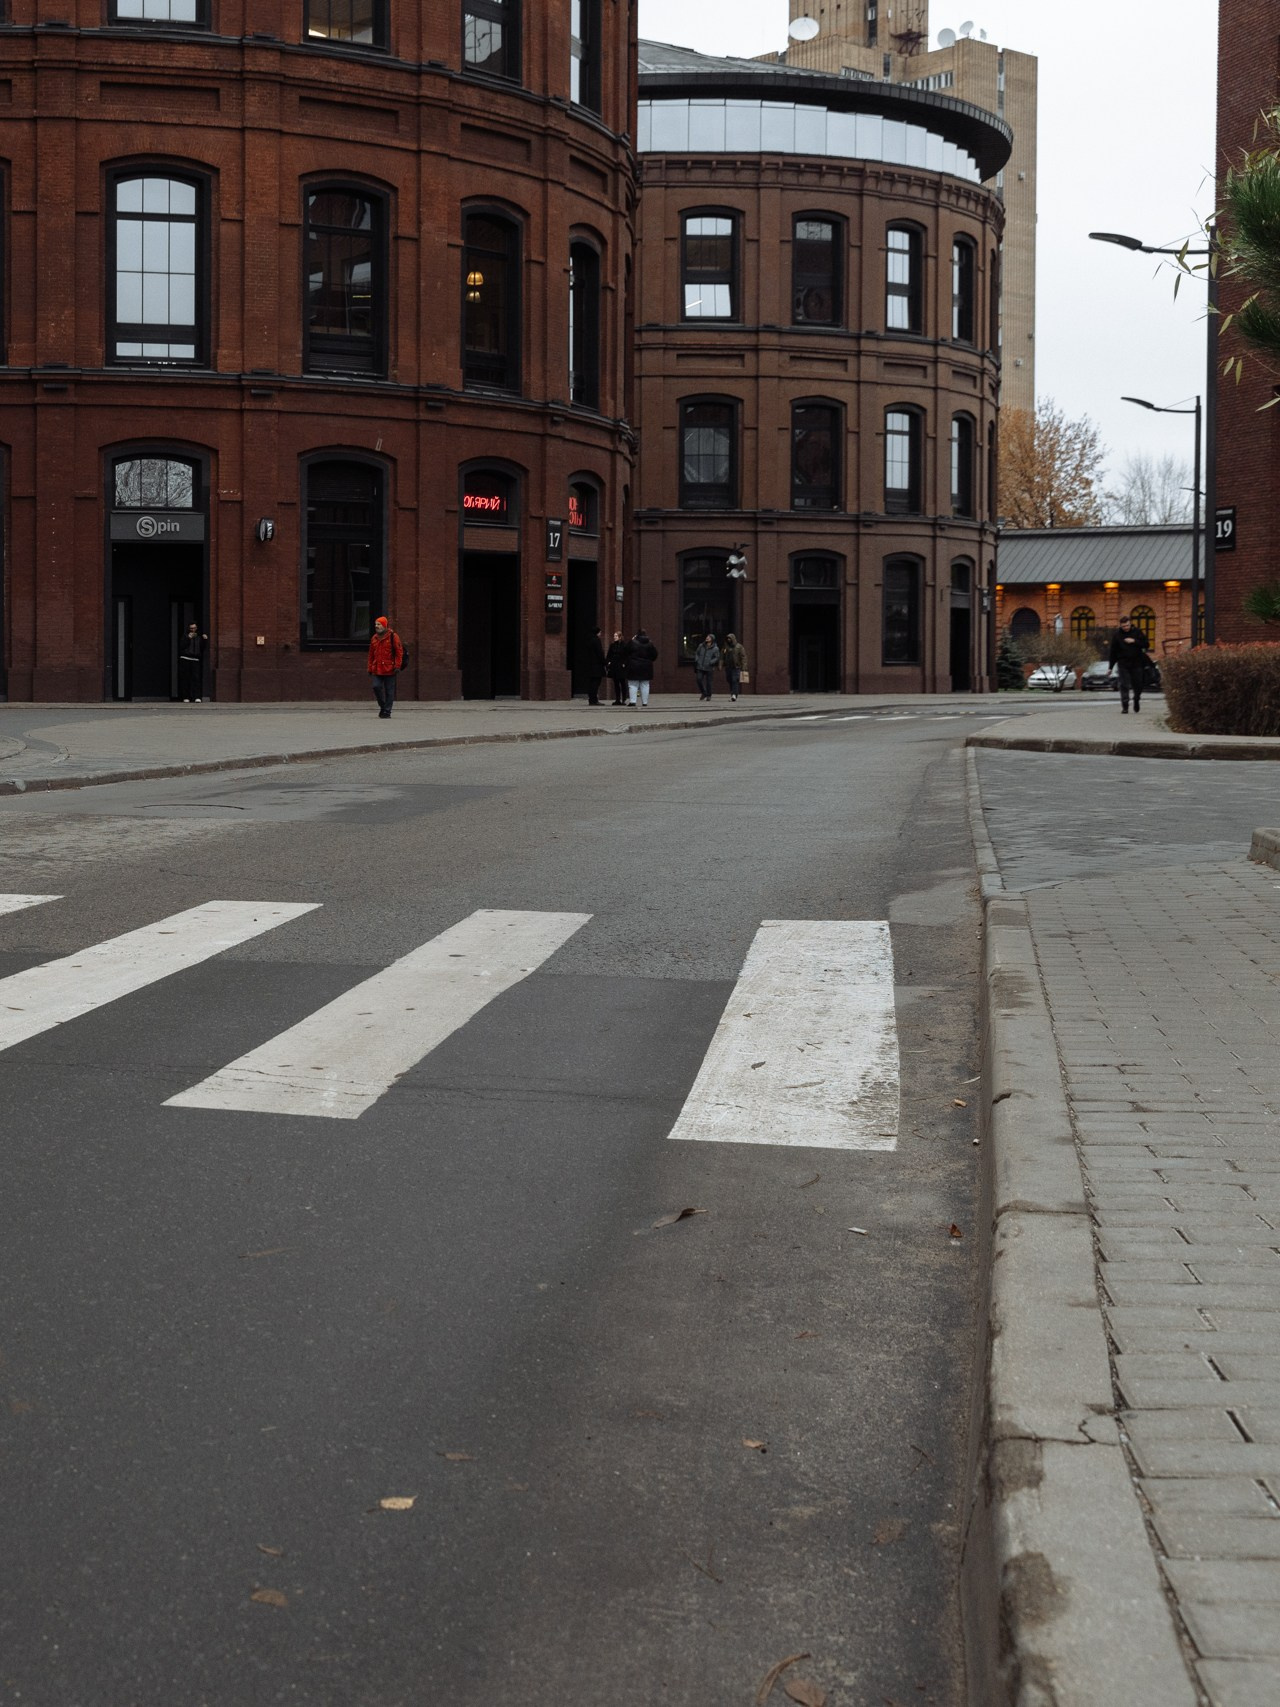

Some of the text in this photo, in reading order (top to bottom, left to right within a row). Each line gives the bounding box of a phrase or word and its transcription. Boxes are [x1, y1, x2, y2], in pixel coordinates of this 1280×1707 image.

[136, 516, 180, 538] Spin
[1215, 519, 1233, 538] 19
[549, 532, 561, 548] 17
